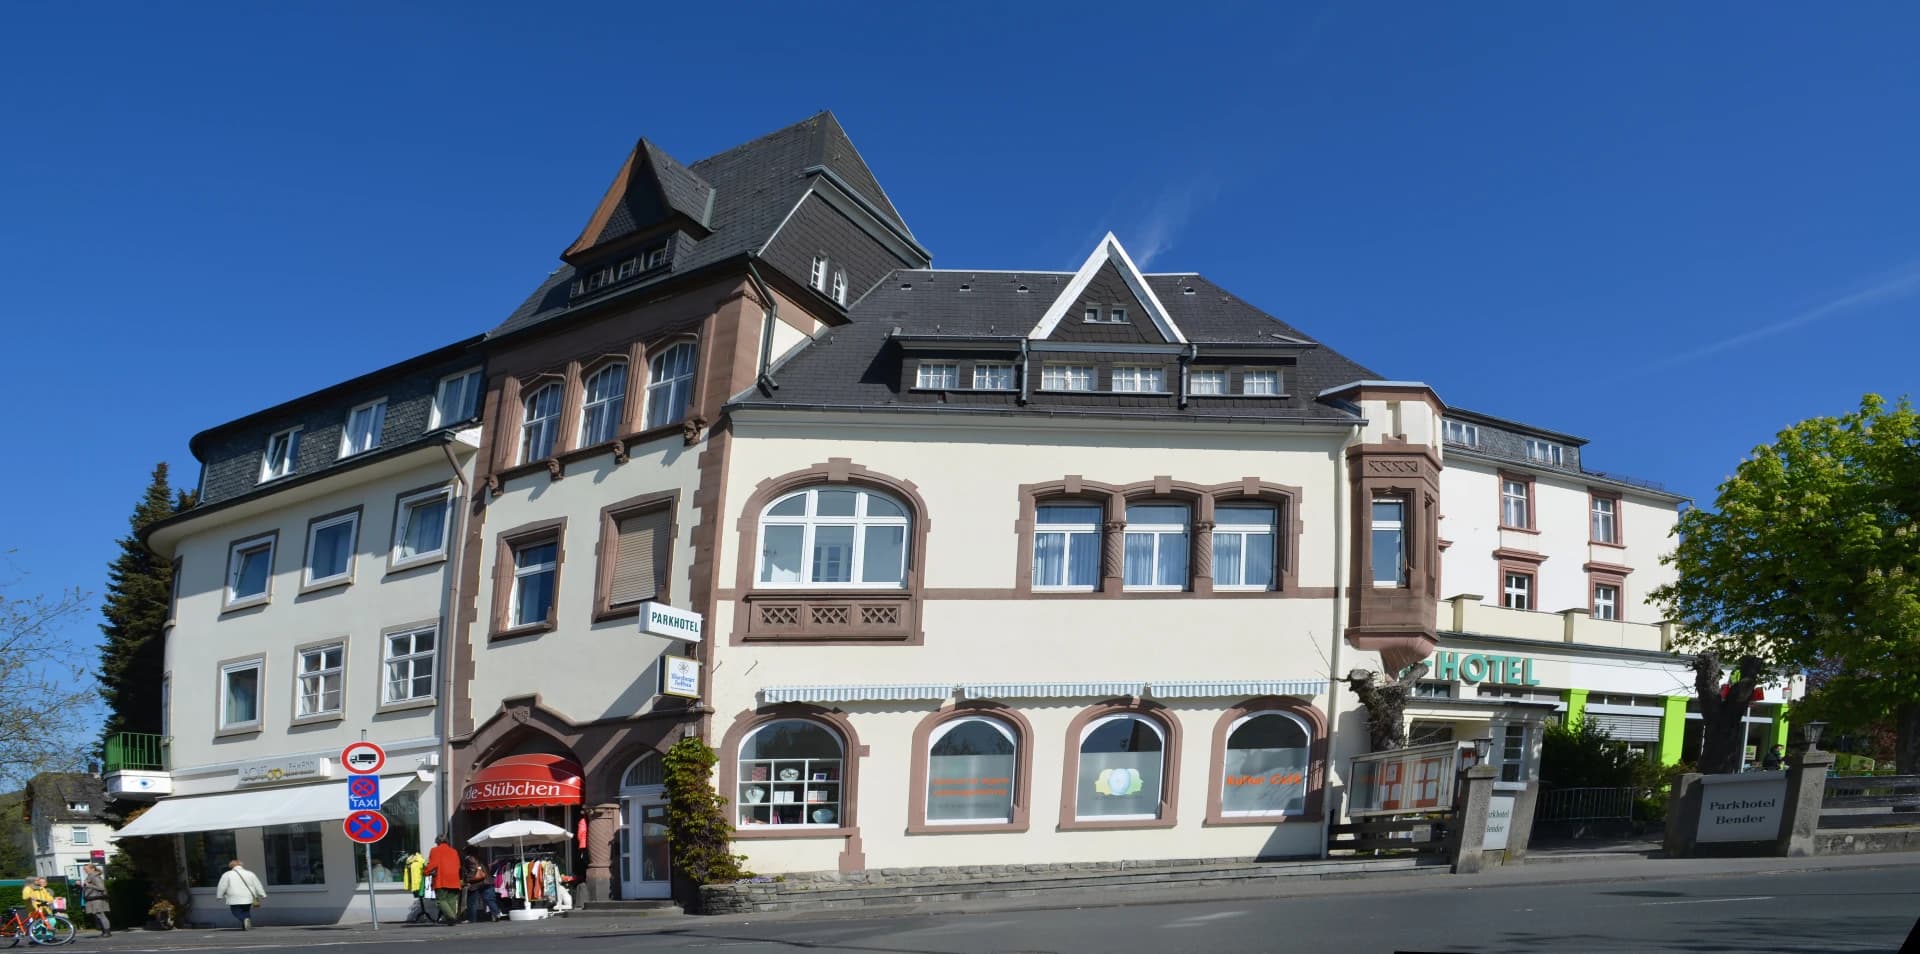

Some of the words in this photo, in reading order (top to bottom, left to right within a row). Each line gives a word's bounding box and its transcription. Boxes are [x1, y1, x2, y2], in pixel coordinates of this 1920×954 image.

[651, 611, 699, 633] PARKHOTEL
[353, 799, 377, 808] TAXI
[1709, 798, 1776, 811] Parkhotel
[1488, 808, 1510, 818] arkhotel
[1715, 814, 1766, 825] Bender
